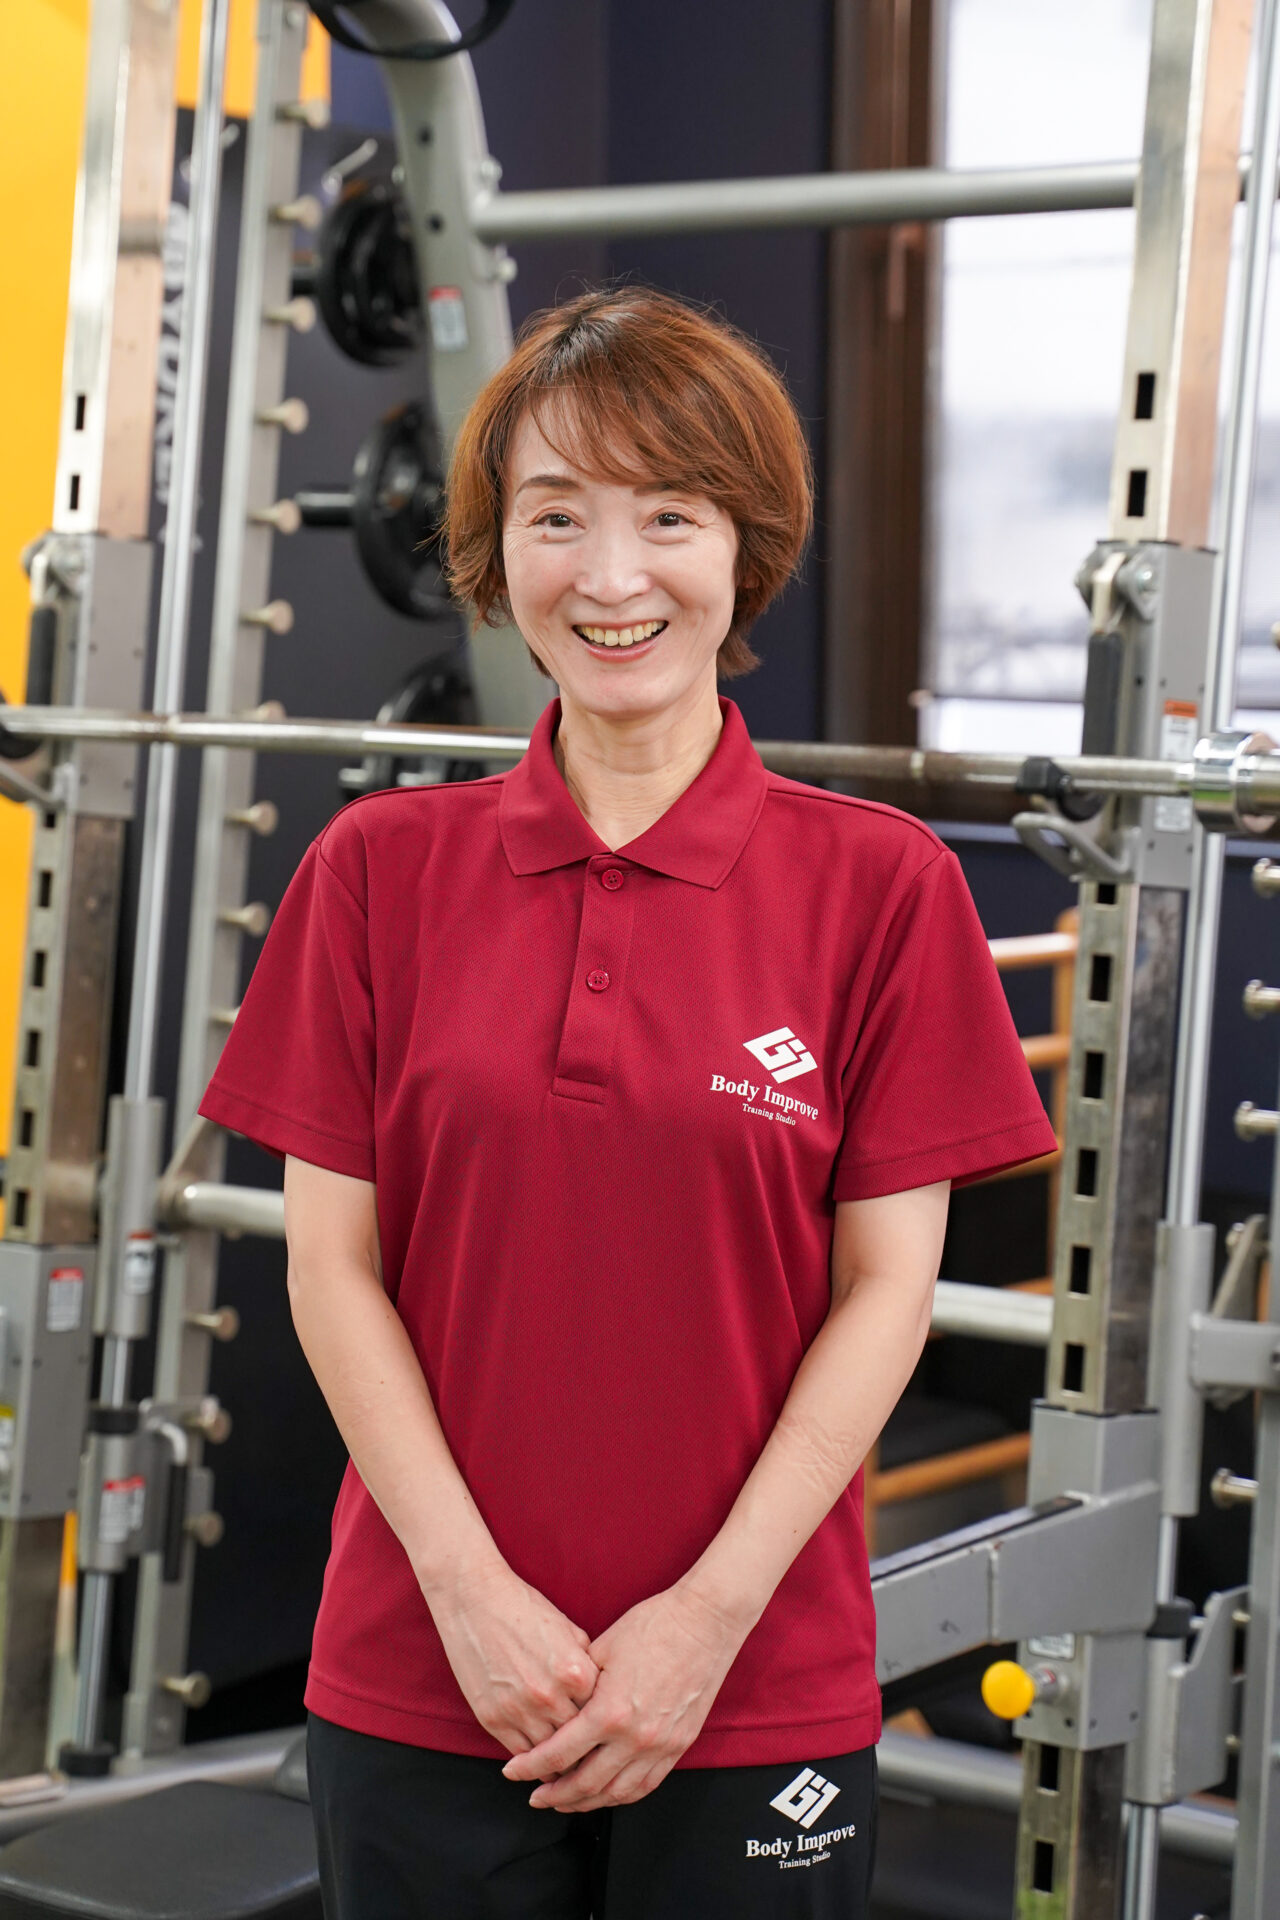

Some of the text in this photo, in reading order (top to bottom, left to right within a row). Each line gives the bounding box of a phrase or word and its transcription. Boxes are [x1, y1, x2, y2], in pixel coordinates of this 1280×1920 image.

[710, 1074, 818, 1120] Body Improve
[743, 1103, 796, 1125] Training Studio
[746, 1825, 855, 1858] Body Improve
[779, 1851, 830, 1868] Training Studio
